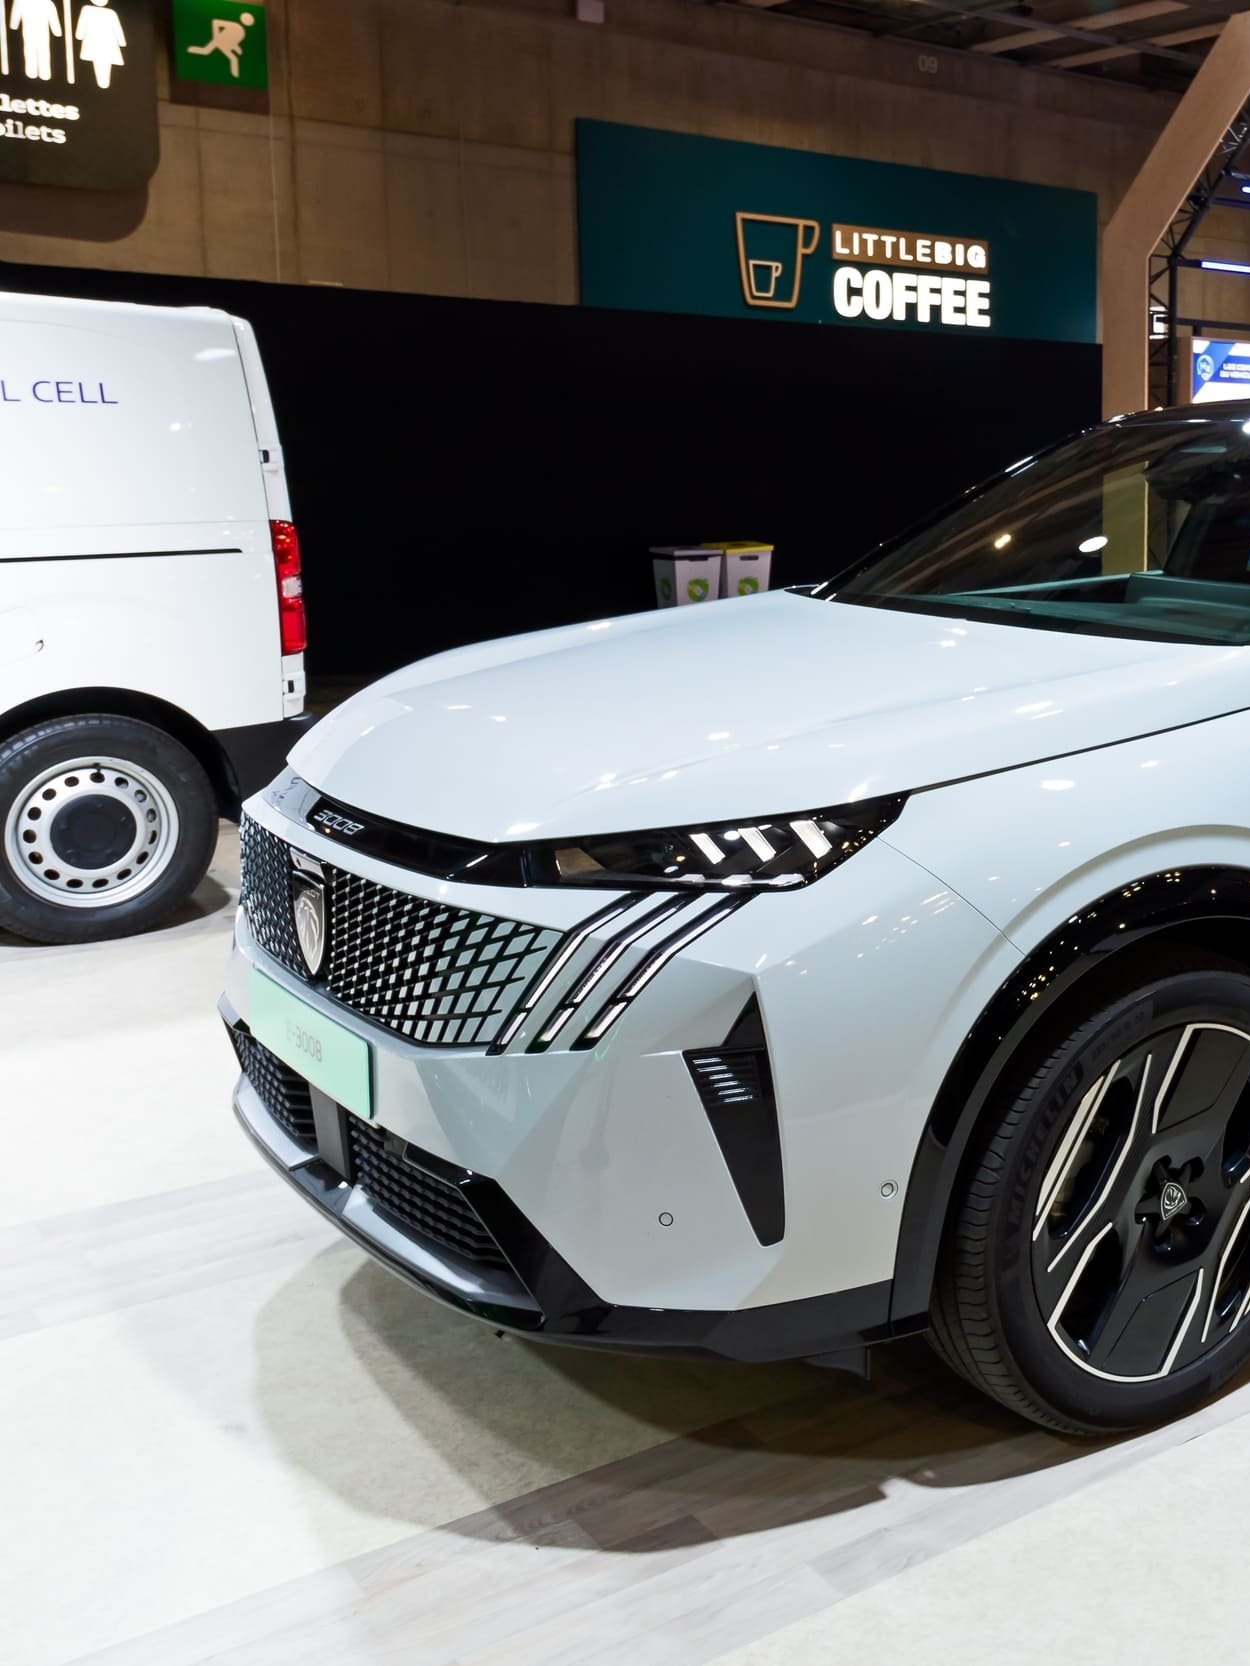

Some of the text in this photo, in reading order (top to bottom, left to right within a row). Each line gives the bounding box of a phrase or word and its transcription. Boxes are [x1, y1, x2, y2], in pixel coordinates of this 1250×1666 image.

[833, 266, 991, 328] COFFEE
[32, 380, 118, 404] CELL
[313, 809, 365, 836] 3008
